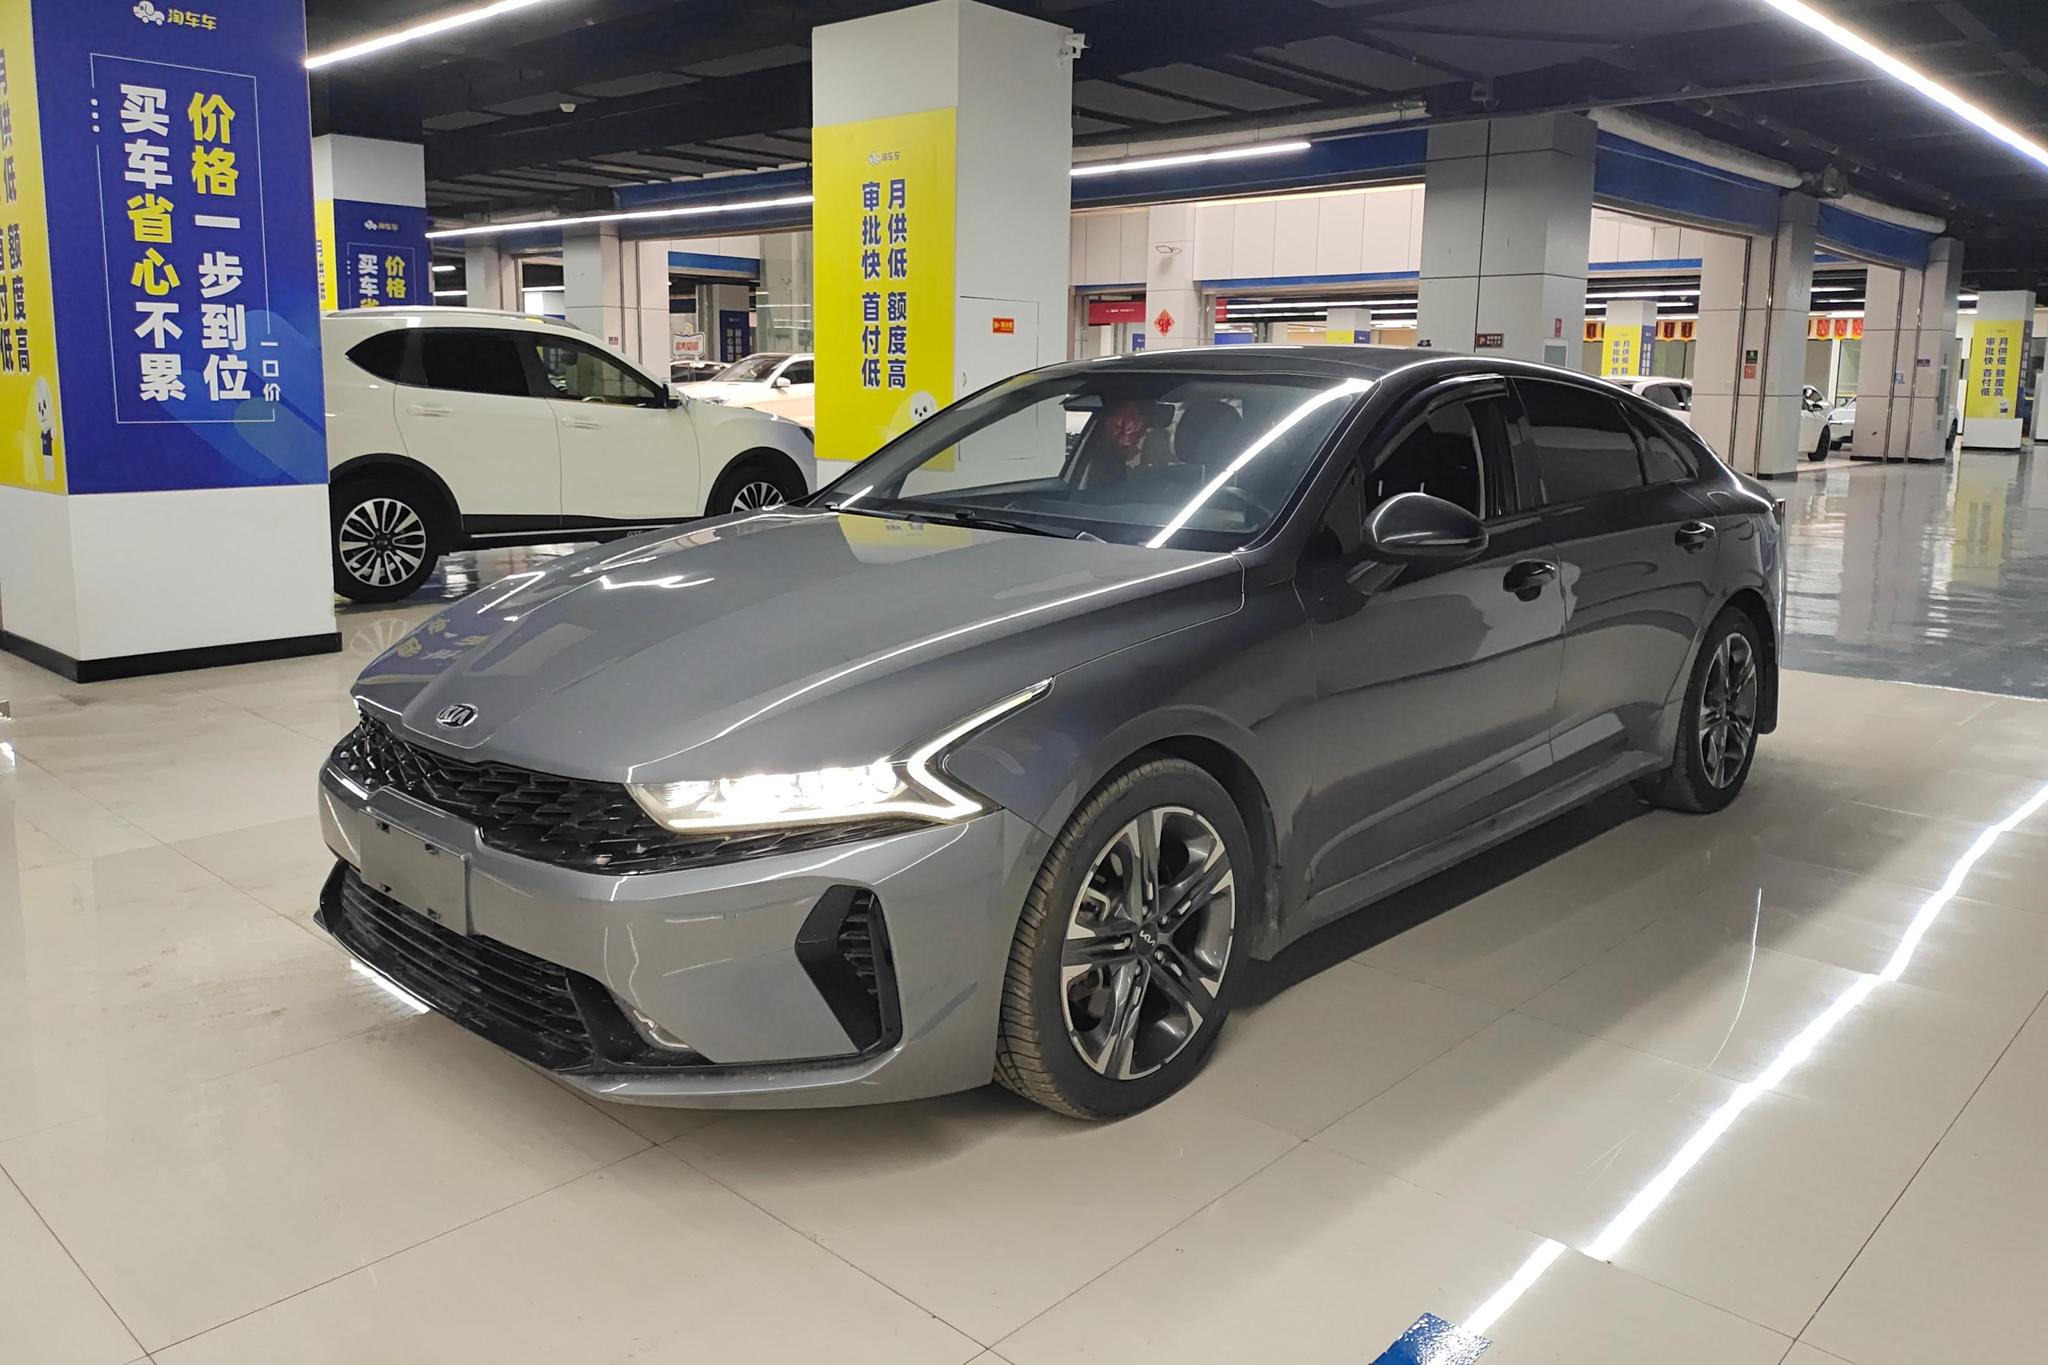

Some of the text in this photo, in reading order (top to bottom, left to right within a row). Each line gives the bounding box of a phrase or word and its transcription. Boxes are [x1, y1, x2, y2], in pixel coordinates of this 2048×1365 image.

[167, 8, 217, 30] 淘车车
[7, 223, 30, 374] 额度高
[118, 82, 187, 402] 买车省心不累
[186, 91, 252, 402] 价格一步到位
[385, 255, 407, 299] 价格
[861, 181, 882, 388] 审批快 首付低
[887, 177, 908, 389] 月供低 额度高
[259, 341, 282, 402] 一口价
[440, 706, 471, 725] KIA
